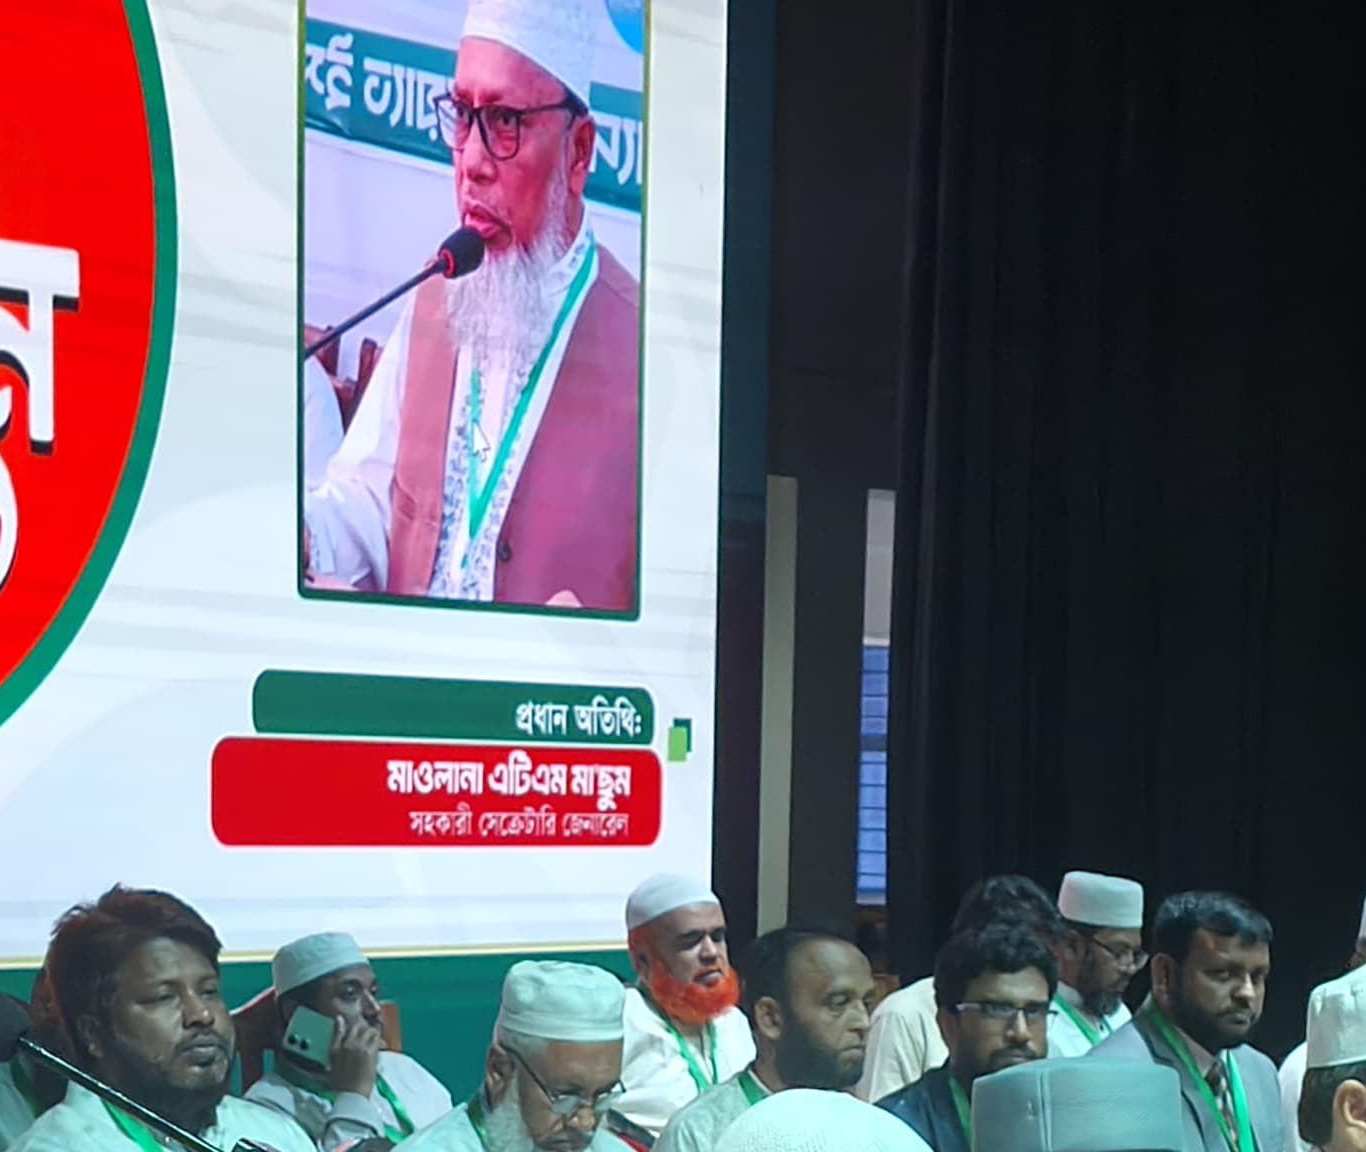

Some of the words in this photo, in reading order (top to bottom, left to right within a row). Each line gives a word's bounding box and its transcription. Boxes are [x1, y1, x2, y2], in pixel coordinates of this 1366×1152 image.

[516, 701, 569, 736] প্রধান
[387, 760, 484, 796] মাওলানা
[487, 749, 568, 797] এটিএম
[571, 764, 632, 813] মাছুম
[408, 801, 473, 837] সহকারী
[478, 803, 557, 837] সেক্রেটারি
